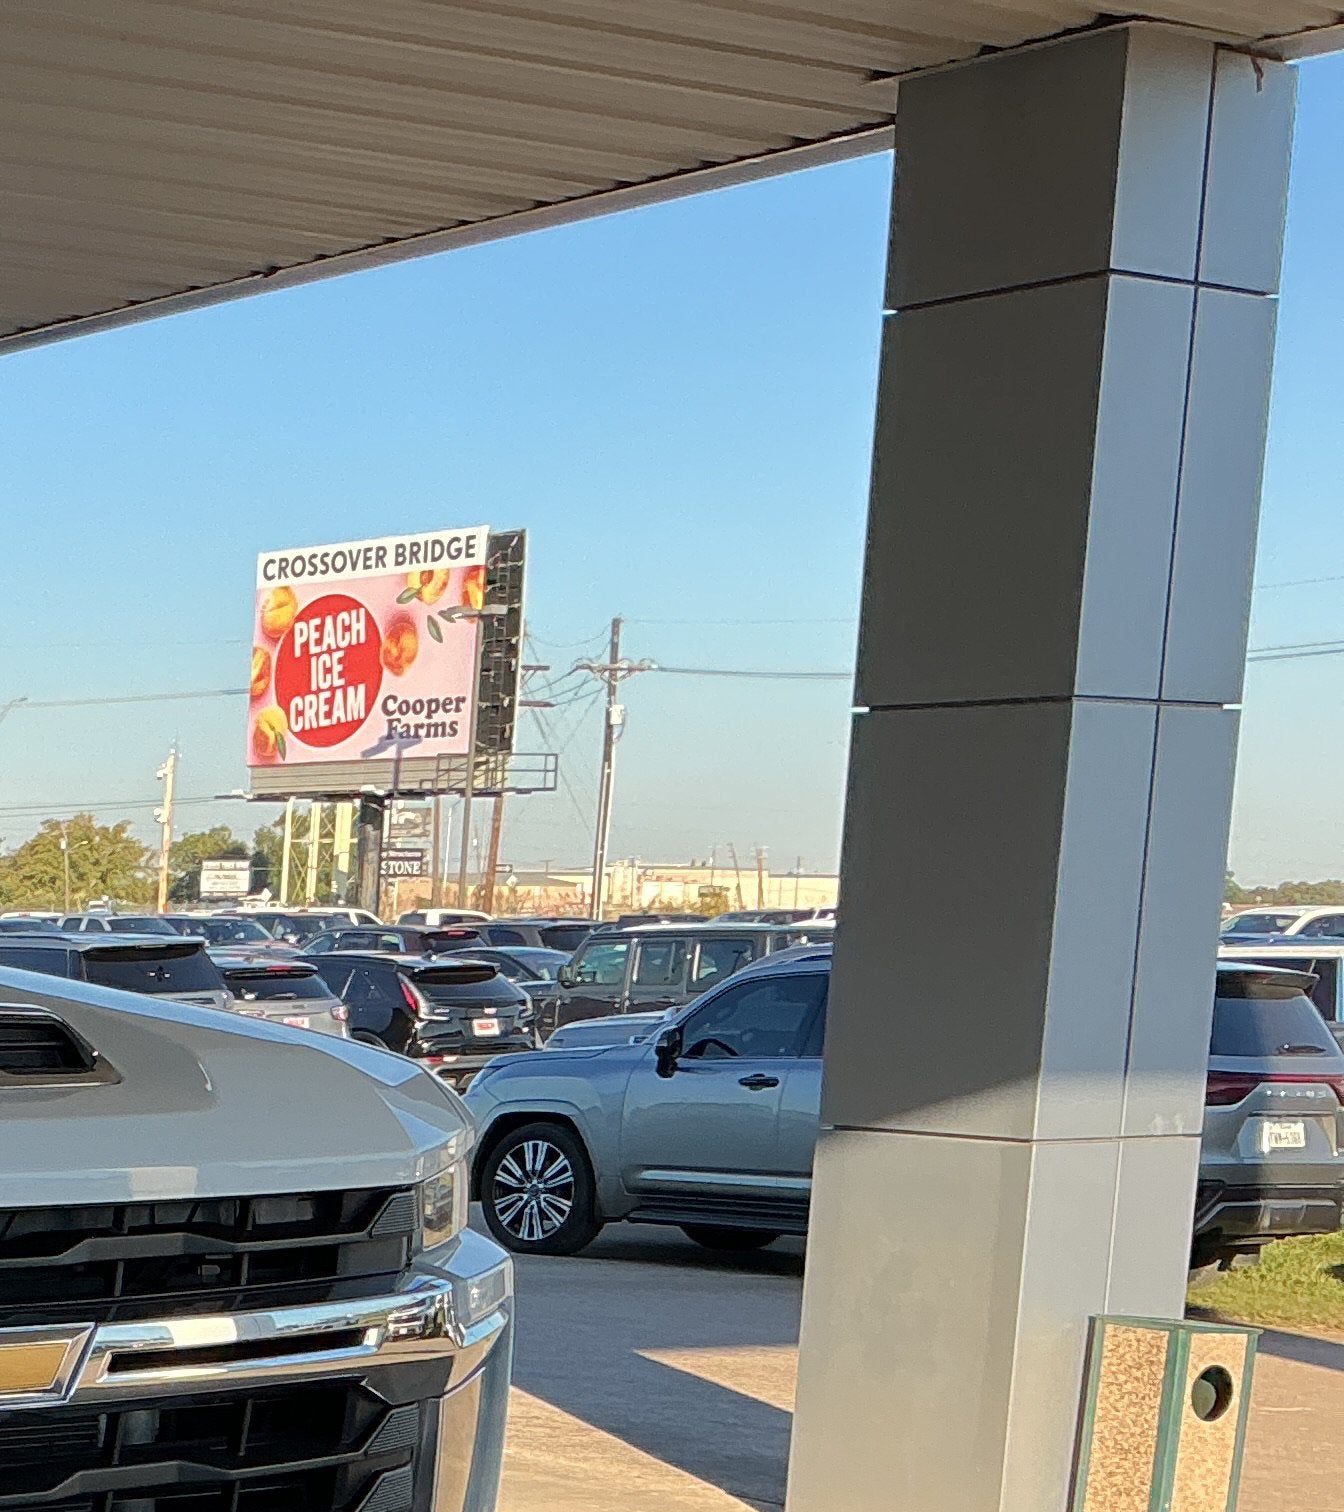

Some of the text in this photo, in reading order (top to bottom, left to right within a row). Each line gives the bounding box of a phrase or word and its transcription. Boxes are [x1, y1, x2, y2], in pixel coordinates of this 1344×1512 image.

[262, 534, 477, 582] CROSSOVER BRIDGE
[293, 607, 367, 657] PEACH
[310, 650, 345, 691] ICE
[289, 683, 367, 734] CREAM
[381, 694, 466, 720] Cooper
[385, 717, 459, 741] Farms
[380, 860, 421, 875] STONE
